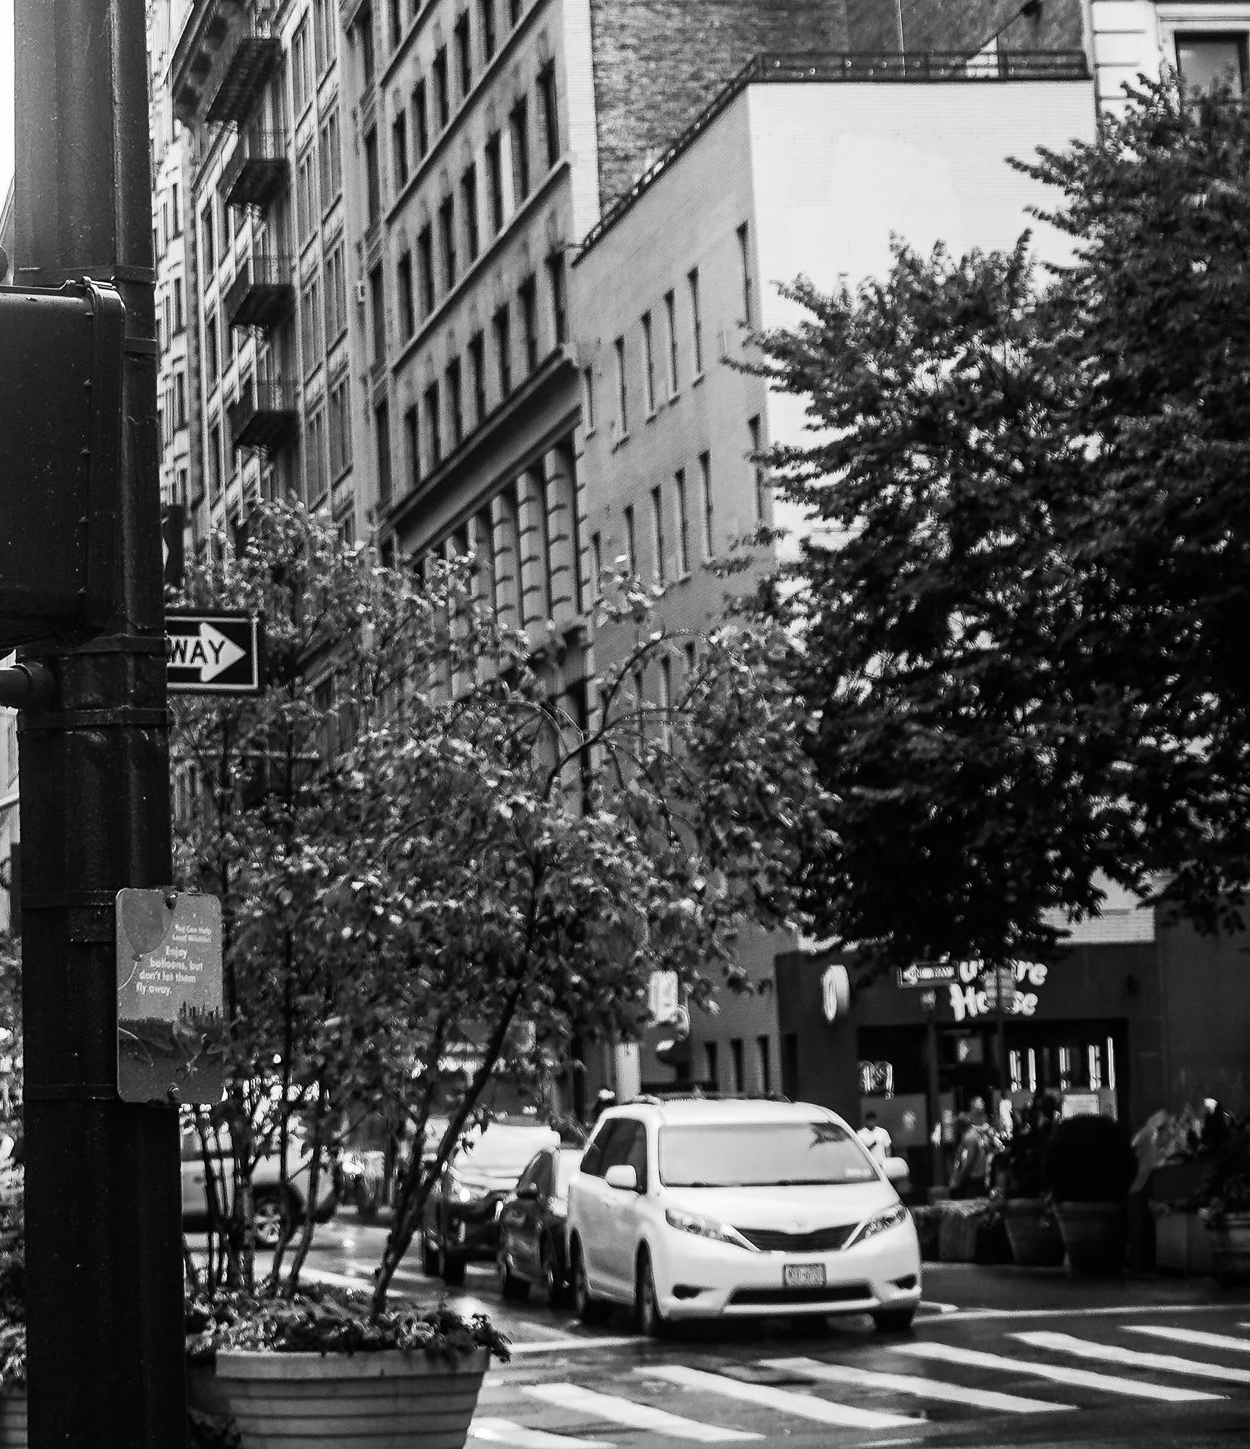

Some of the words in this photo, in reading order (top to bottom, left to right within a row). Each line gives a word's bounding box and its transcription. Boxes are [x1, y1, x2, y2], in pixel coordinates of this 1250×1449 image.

[165, 945, 188, 960] Enjoy
[162, 970, 174, 982] let
[175, 972, 197, 984] them
